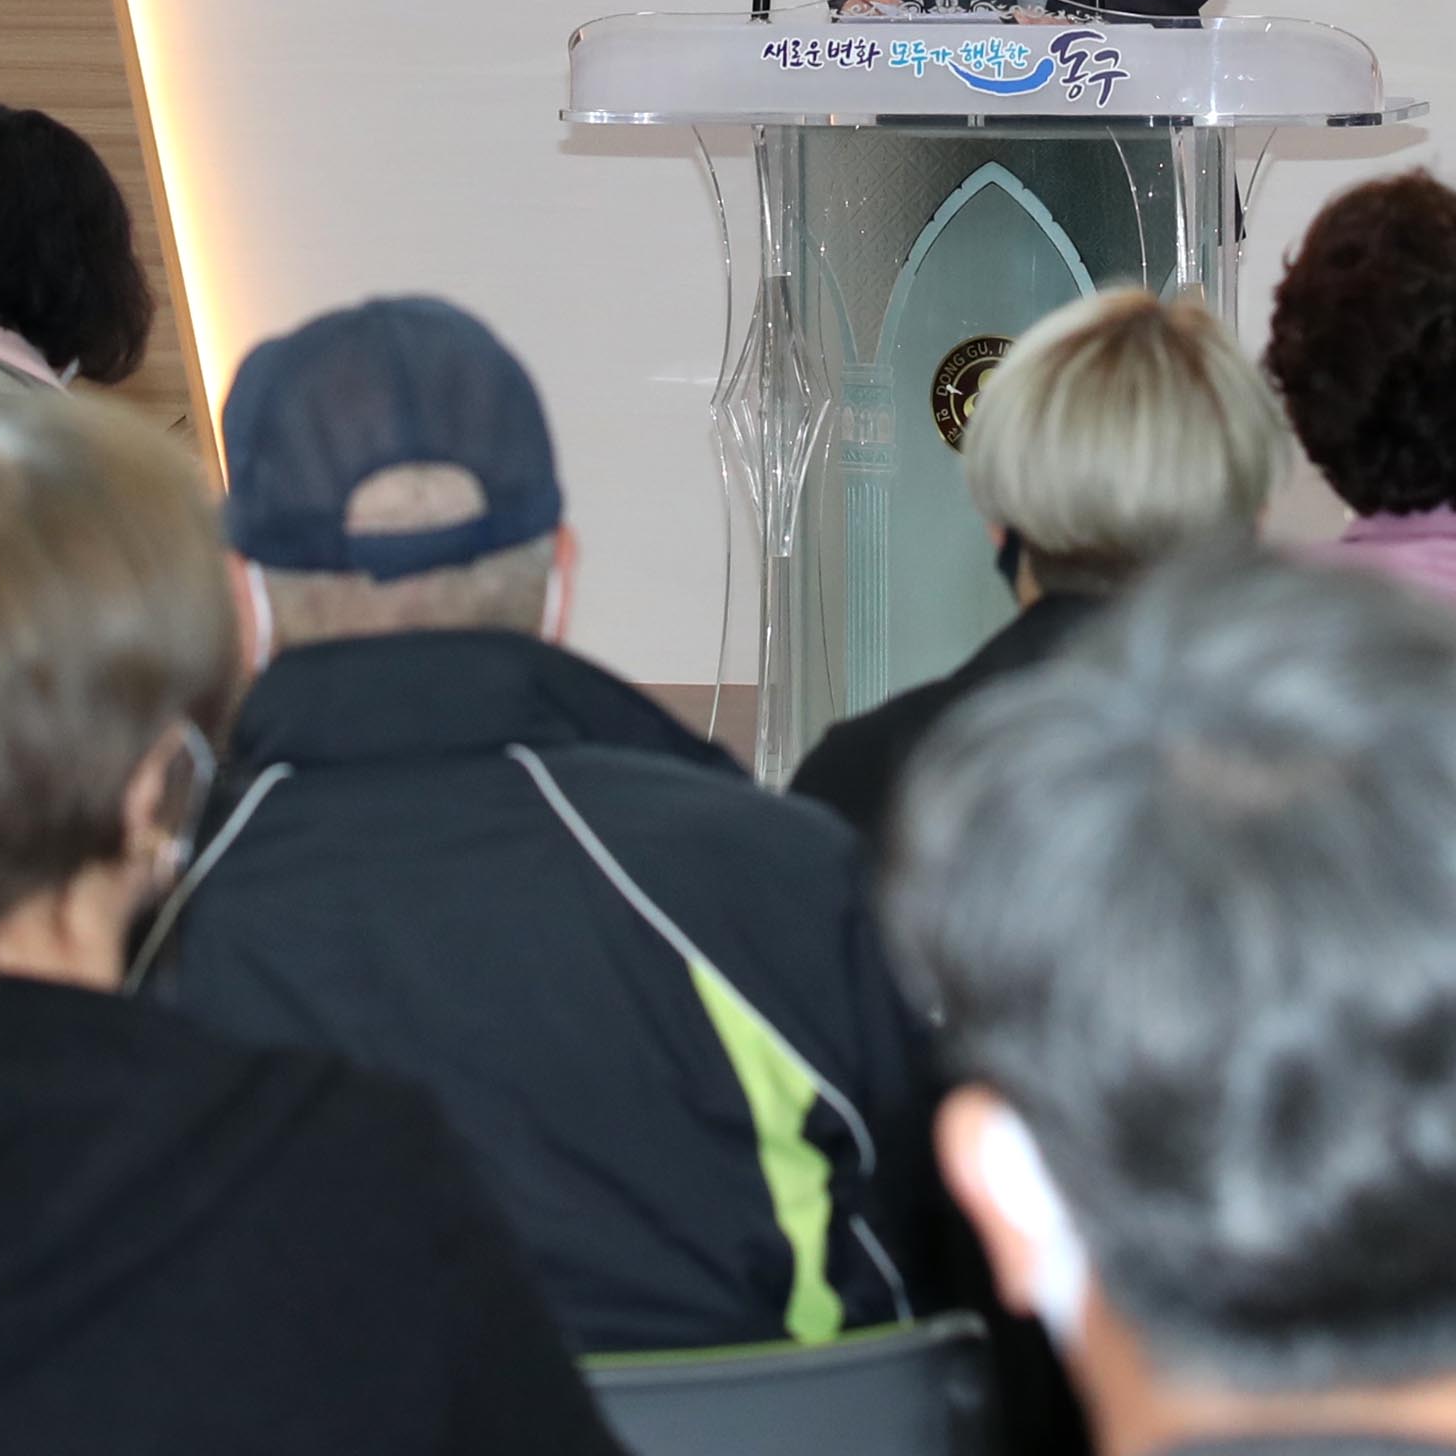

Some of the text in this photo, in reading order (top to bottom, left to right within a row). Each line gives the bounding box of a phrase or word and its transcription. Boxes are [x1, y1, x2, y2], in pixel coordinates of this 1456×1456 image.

[763, 30, 1130, 104] 새로운 변화 모두가 행복한 동구
[936, 354, 966, 397] DONG
